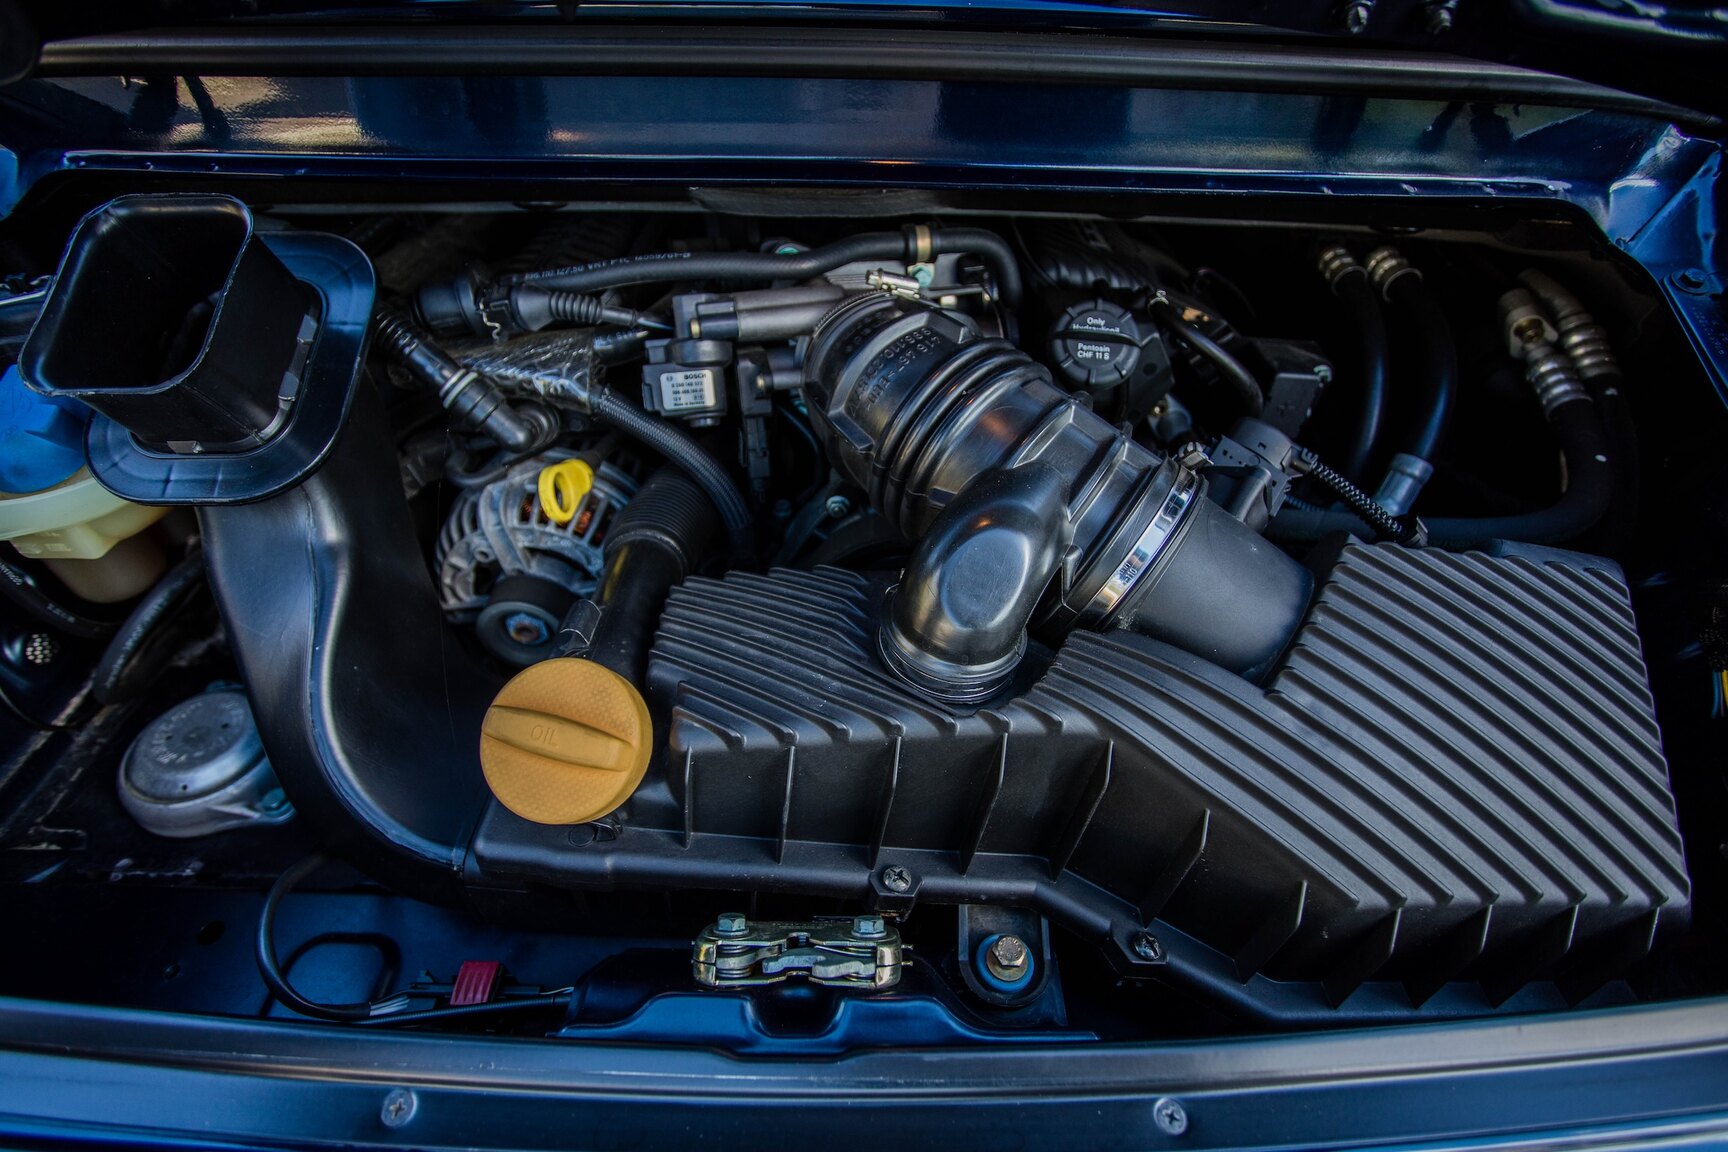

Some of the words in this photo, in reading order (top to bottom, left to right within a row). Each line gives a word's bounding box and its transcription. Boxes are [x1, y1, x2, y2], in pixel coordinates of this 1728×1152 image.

[1086, 317, 1105, 326] Only
[1078, 343, 1110, 352] Pentosin
[1077, 351, 1094, 359] CHF
[531, 724, 559, 747] OIL
